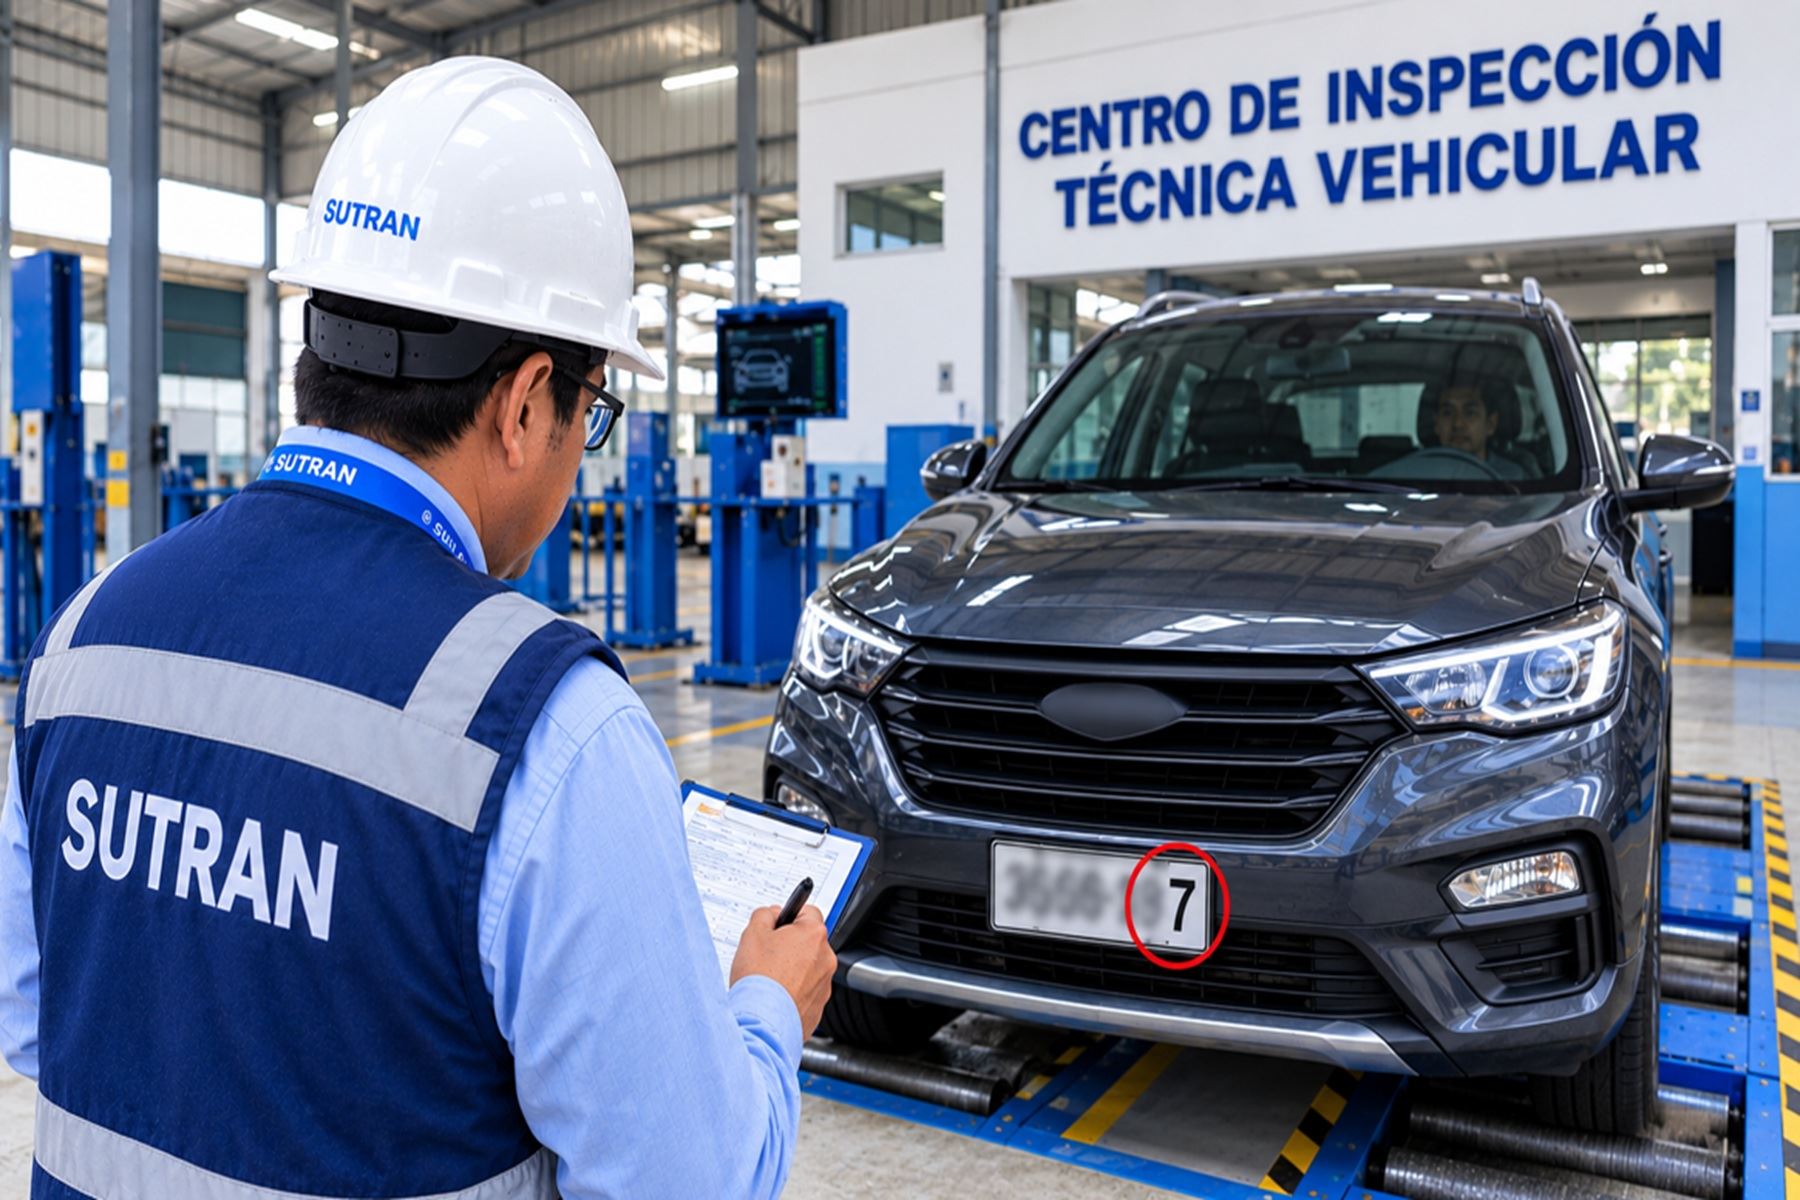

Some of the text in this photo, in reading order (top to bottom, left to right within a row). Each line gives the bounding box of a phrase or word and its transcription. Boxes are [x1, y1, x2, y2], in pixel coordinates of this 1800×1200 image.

[1018, 12, 1722, 160] CENTRO DE INSPECCIÓN
[1054, 112, 1701, 229] TÉCNICA VEHICULAR
[323, 198, 422, 242] SUTRAN
[273, 453, 359, 487] SUTRAN
[61, 777, 338, 942] SUTRAN
[1169, 878, 1196, 932] 7
